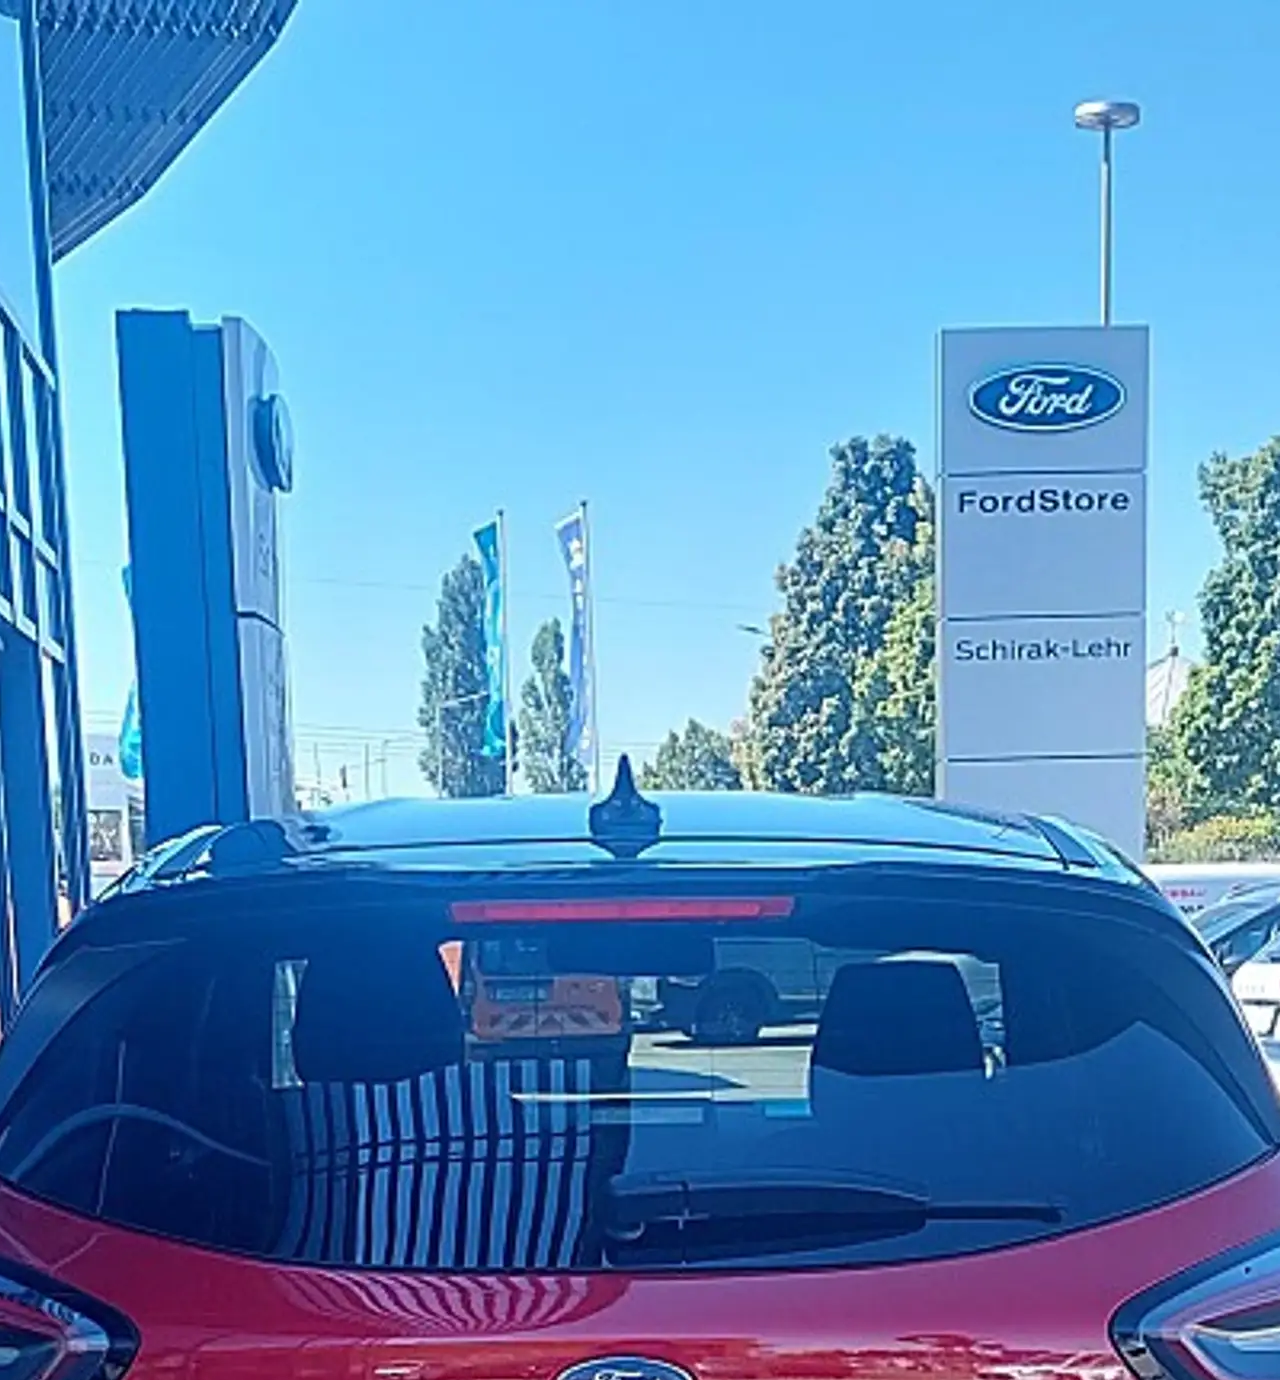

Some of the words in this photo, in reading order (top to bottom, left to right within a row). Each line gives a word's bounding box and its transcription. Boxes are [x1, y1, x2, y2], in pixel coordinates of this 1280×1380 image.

[998, 373, 1094, 417] Ford
[957, 489, 1130, 514] FordStore
[955, 638, 1133, 662] Schirak-Lehr
